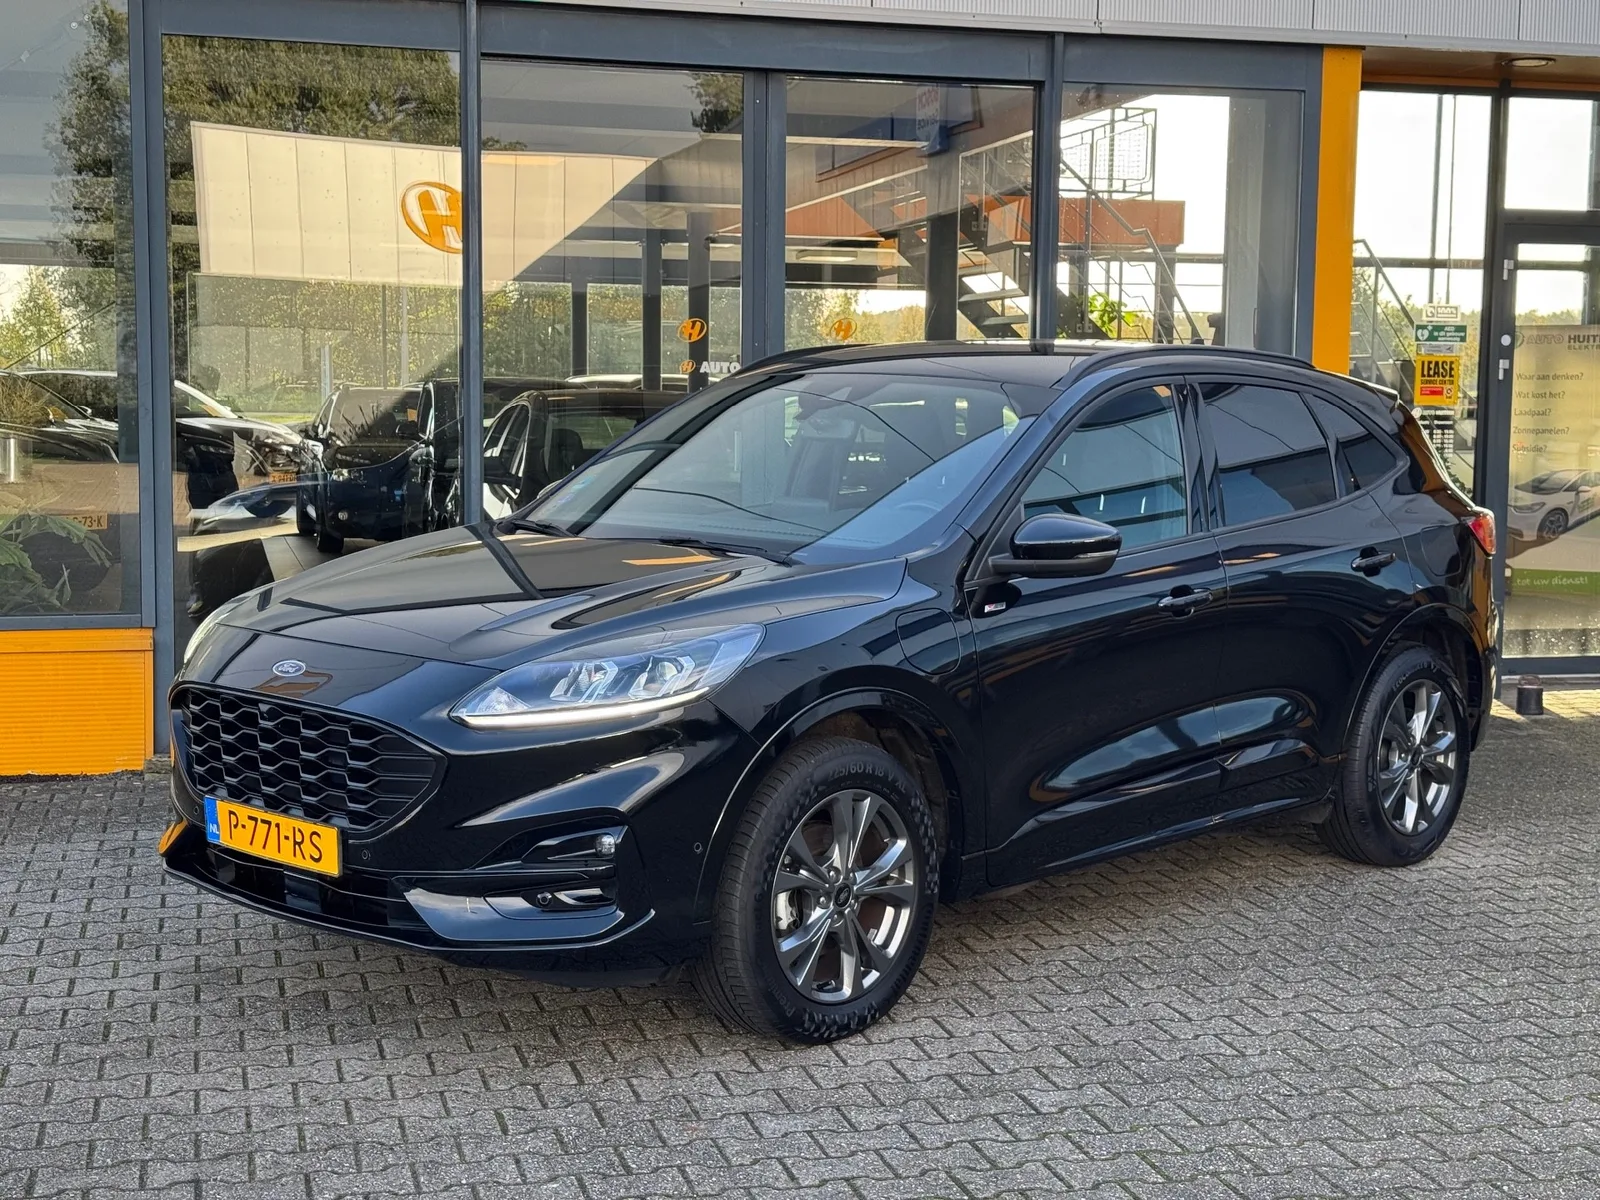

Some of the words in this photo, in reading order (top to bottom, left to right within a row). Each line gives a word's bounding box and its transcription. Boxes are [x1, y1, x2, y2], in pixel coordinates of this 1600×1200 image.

[1568, 333, 1600, 344] HUIT
[700, 362, 741, 374] AUTO
[1420, 360, 1455, 379] LEASE
[1515, 372, 1534, 381] Waar
[1536, 373, 1551, 381] aan
[1552, 372, 1584, 381] denken?
[1515, 390, 1530, 399] Wat
[1531, 391, 1547, 399] kost
[1548, 390, 1566, 399] het?
[1514, 408, 1552, 418] Laadpaal?
[1512, 426, 1570, 436] Zonnepanelen?
[209, 823, 220, 835] NL
[227, 809, 323, 863] P-771-RS
